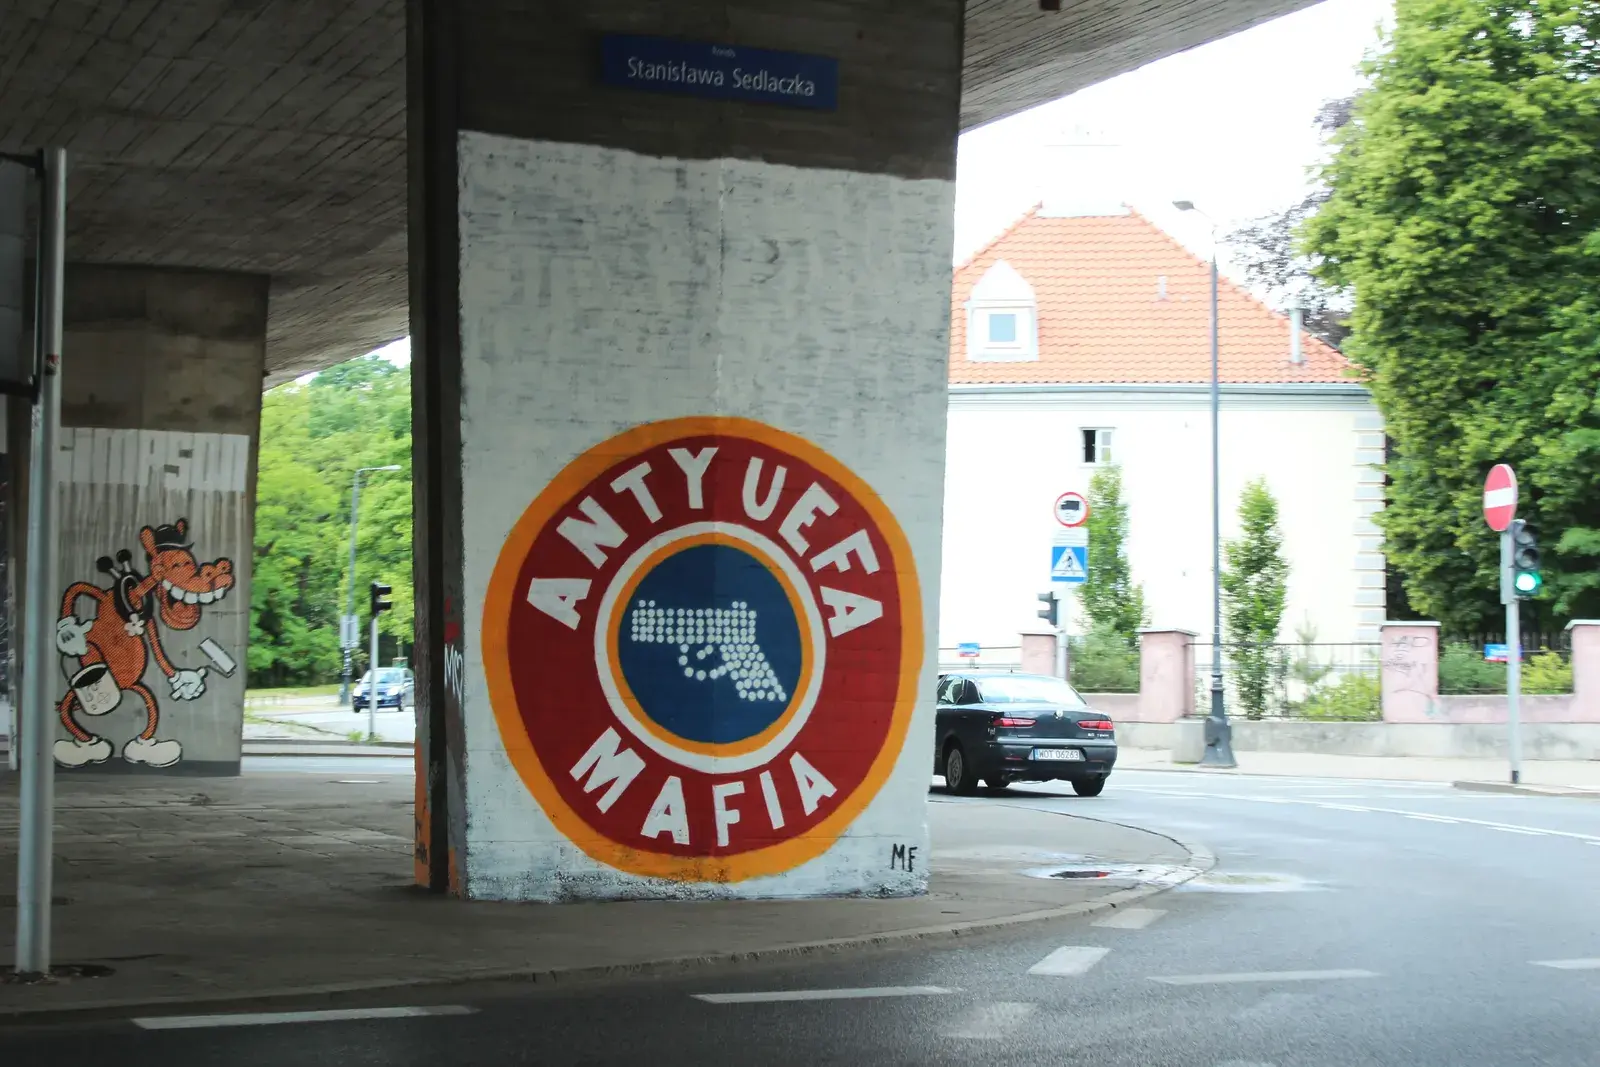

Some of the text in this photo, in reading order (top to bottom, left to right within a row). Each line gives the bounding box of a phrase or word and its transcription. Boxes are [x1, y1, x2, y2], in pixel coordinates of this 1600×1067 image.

[627, 56, 816, 97] Stanisława Sedlaczka
[569, 726, 838, 847] MAFIA
[890, 843, 918, 872] MF
